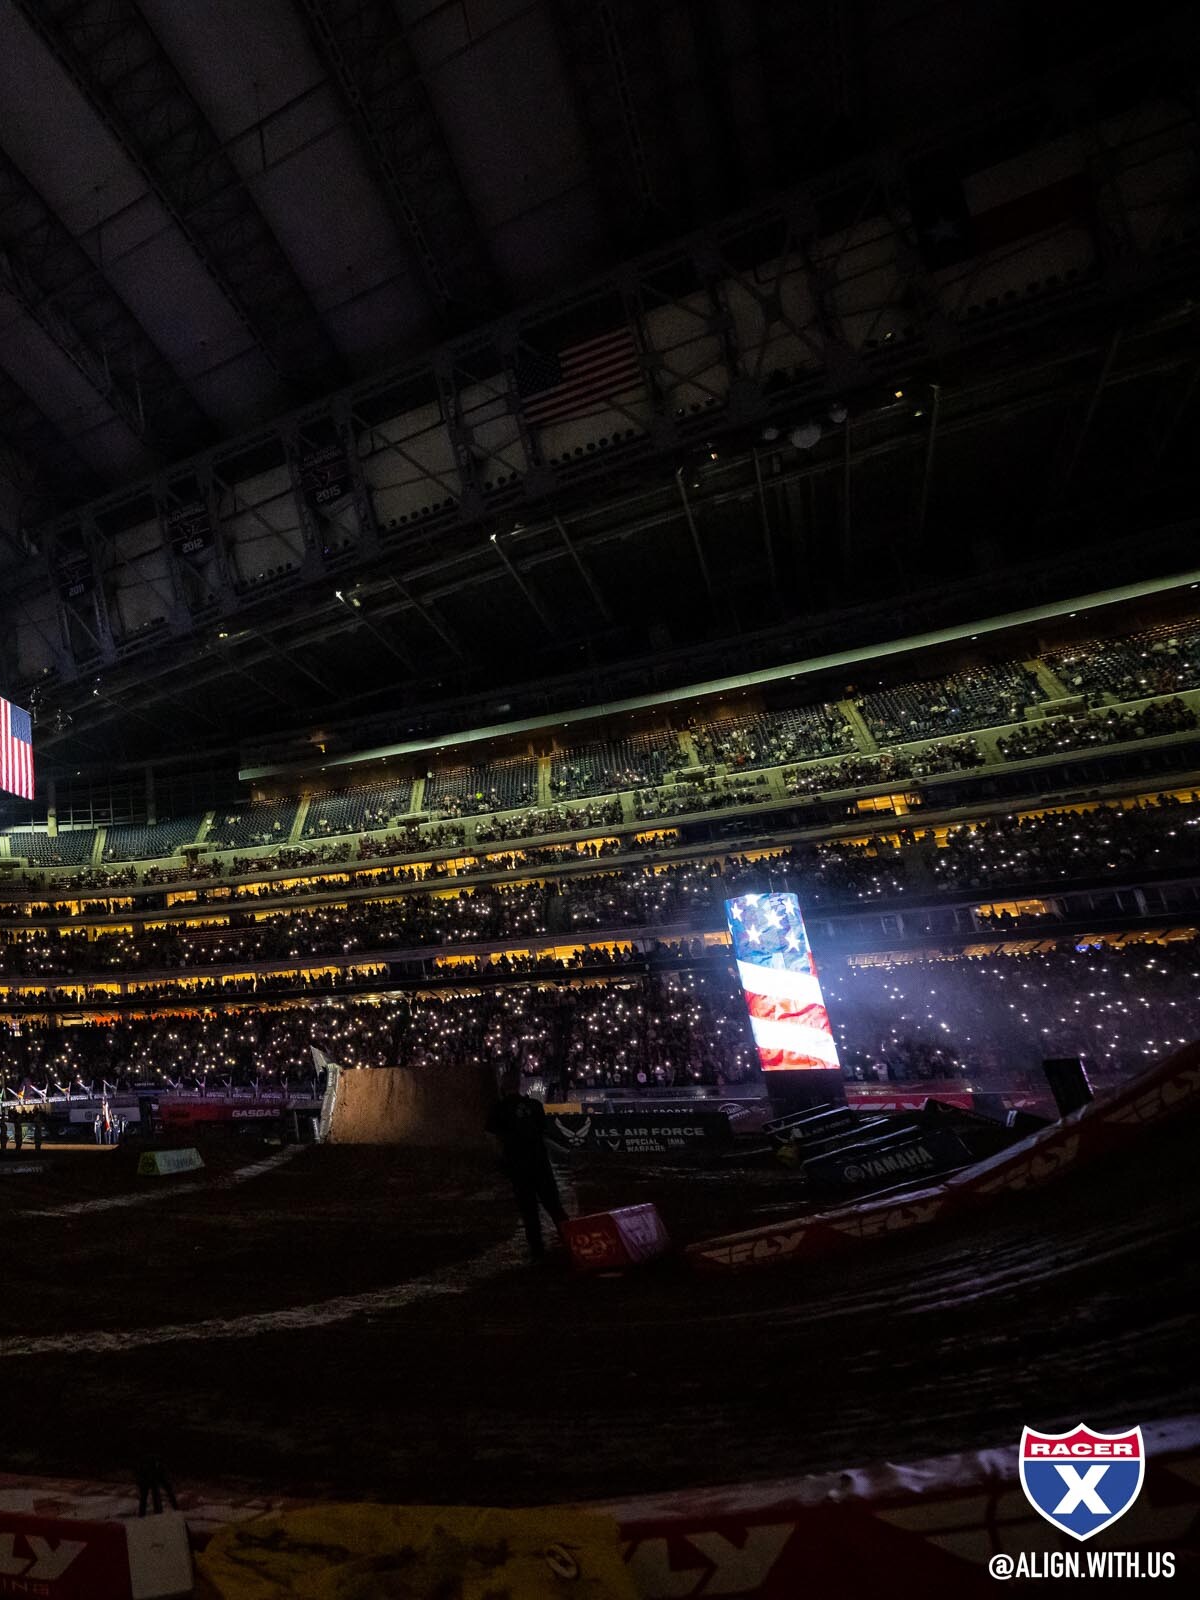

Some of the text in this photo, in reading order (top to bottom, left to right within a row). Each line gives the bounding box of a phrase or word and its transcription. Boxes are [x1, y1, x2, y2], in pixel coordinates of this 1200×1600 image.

[231, 1109, 281, 1118] GASGAS
[624, 1128, 649, 1136] AIR
[651, 1127, 705, 1136] FORCE
[860, 1145, 934, 1178] YAMAHA
